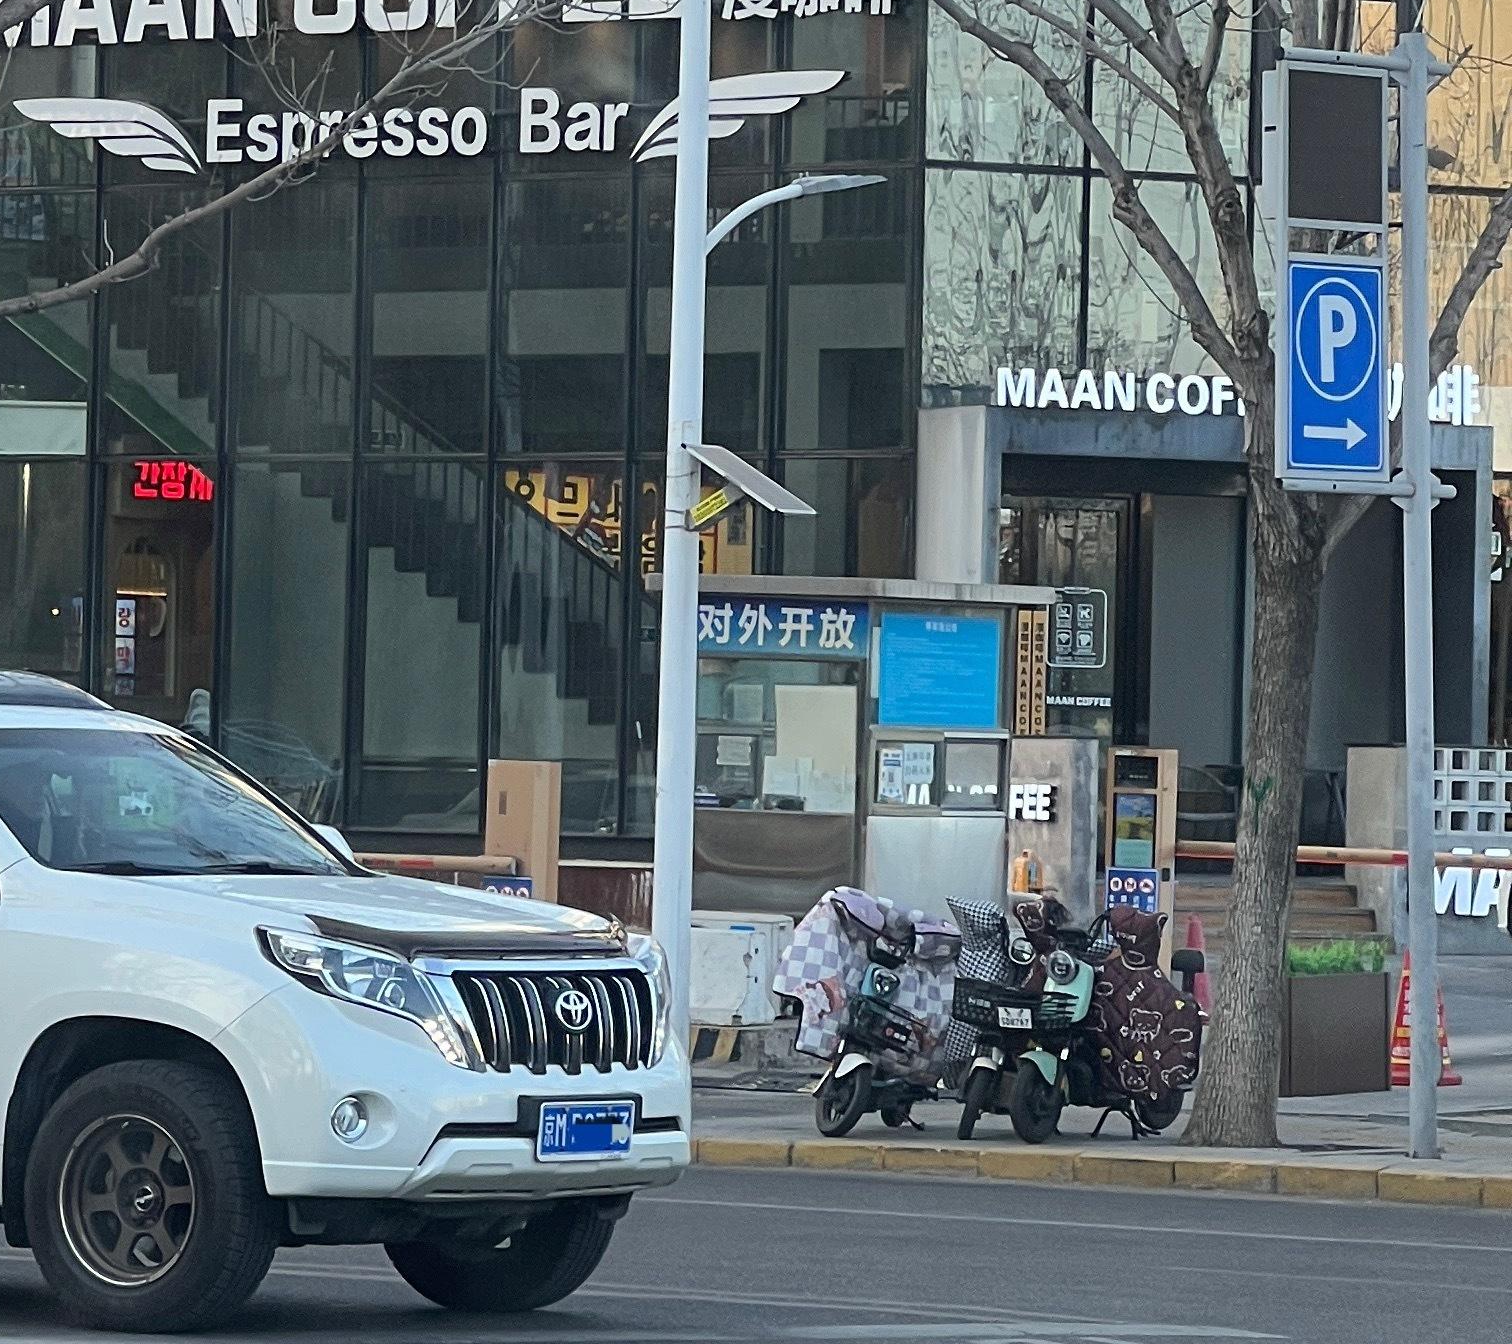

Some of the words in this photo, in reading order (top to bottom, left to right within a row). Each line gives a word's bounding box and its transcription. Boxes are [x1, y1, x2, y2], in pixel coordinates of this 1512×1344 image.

[205, 98, 488, 164] Espresso
[518, 87, 630, 155] Bar
[1318, 294, 1357, 383] P
[996, 367, 1135, 411] MAAN
[1145, 373, 1245, 416] COF
[699, 602, 856, 650] 对外开放
[1046, 696, 1075, 706] MAAN
[1076, 696, 1111, 707] COFFEE
